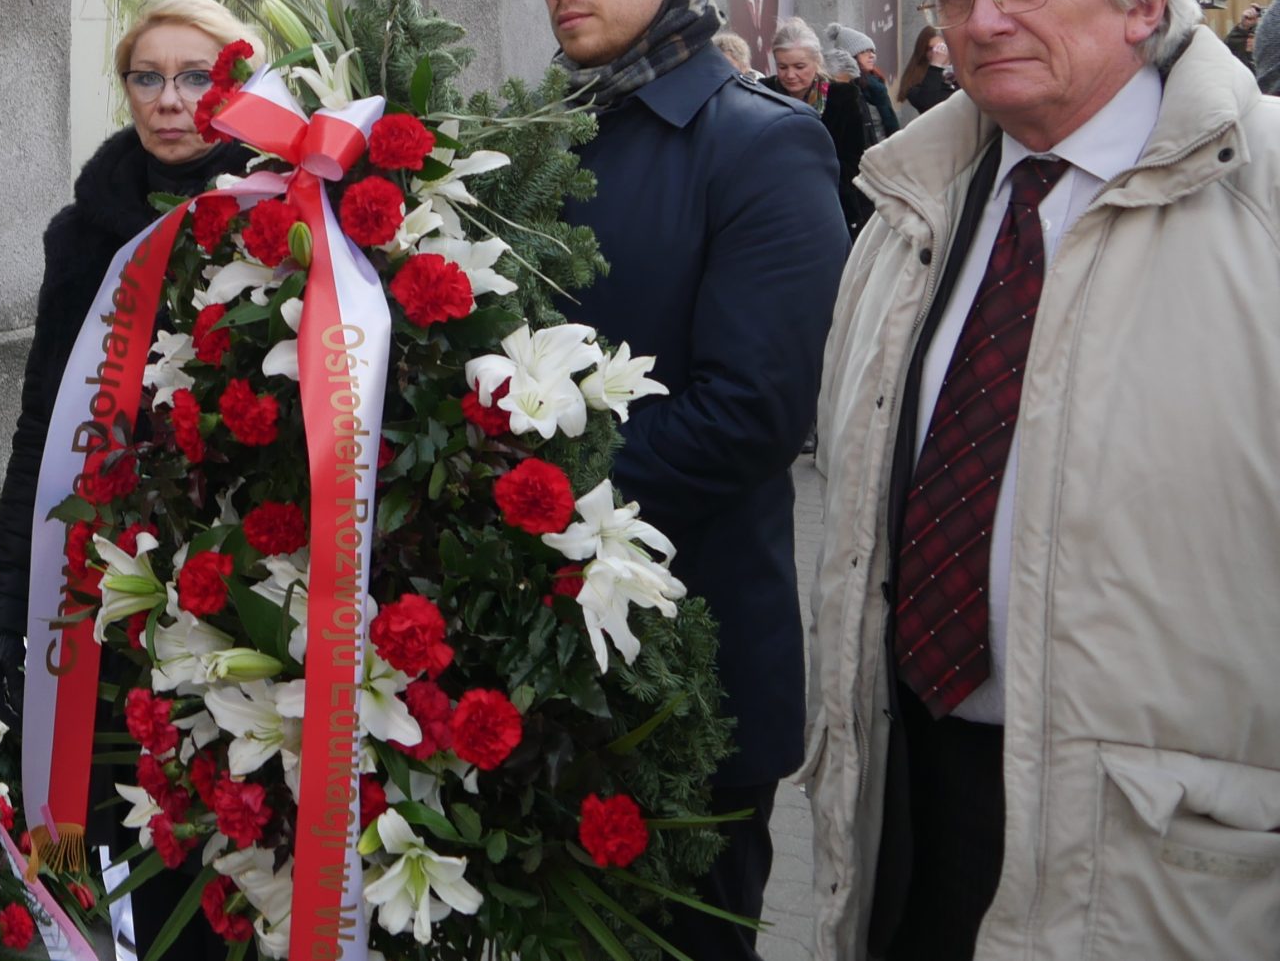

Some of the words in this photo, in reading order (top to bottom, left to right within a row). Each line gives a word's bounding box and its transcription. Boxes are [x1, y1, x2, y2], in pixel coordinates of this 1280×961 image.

[321, 324, 371, 484] Ośrodek
[317, 498, 370, 668] Rozwoju
[311, 682, 364, 850] Edukacji
[318, 862, 352, 893] w
